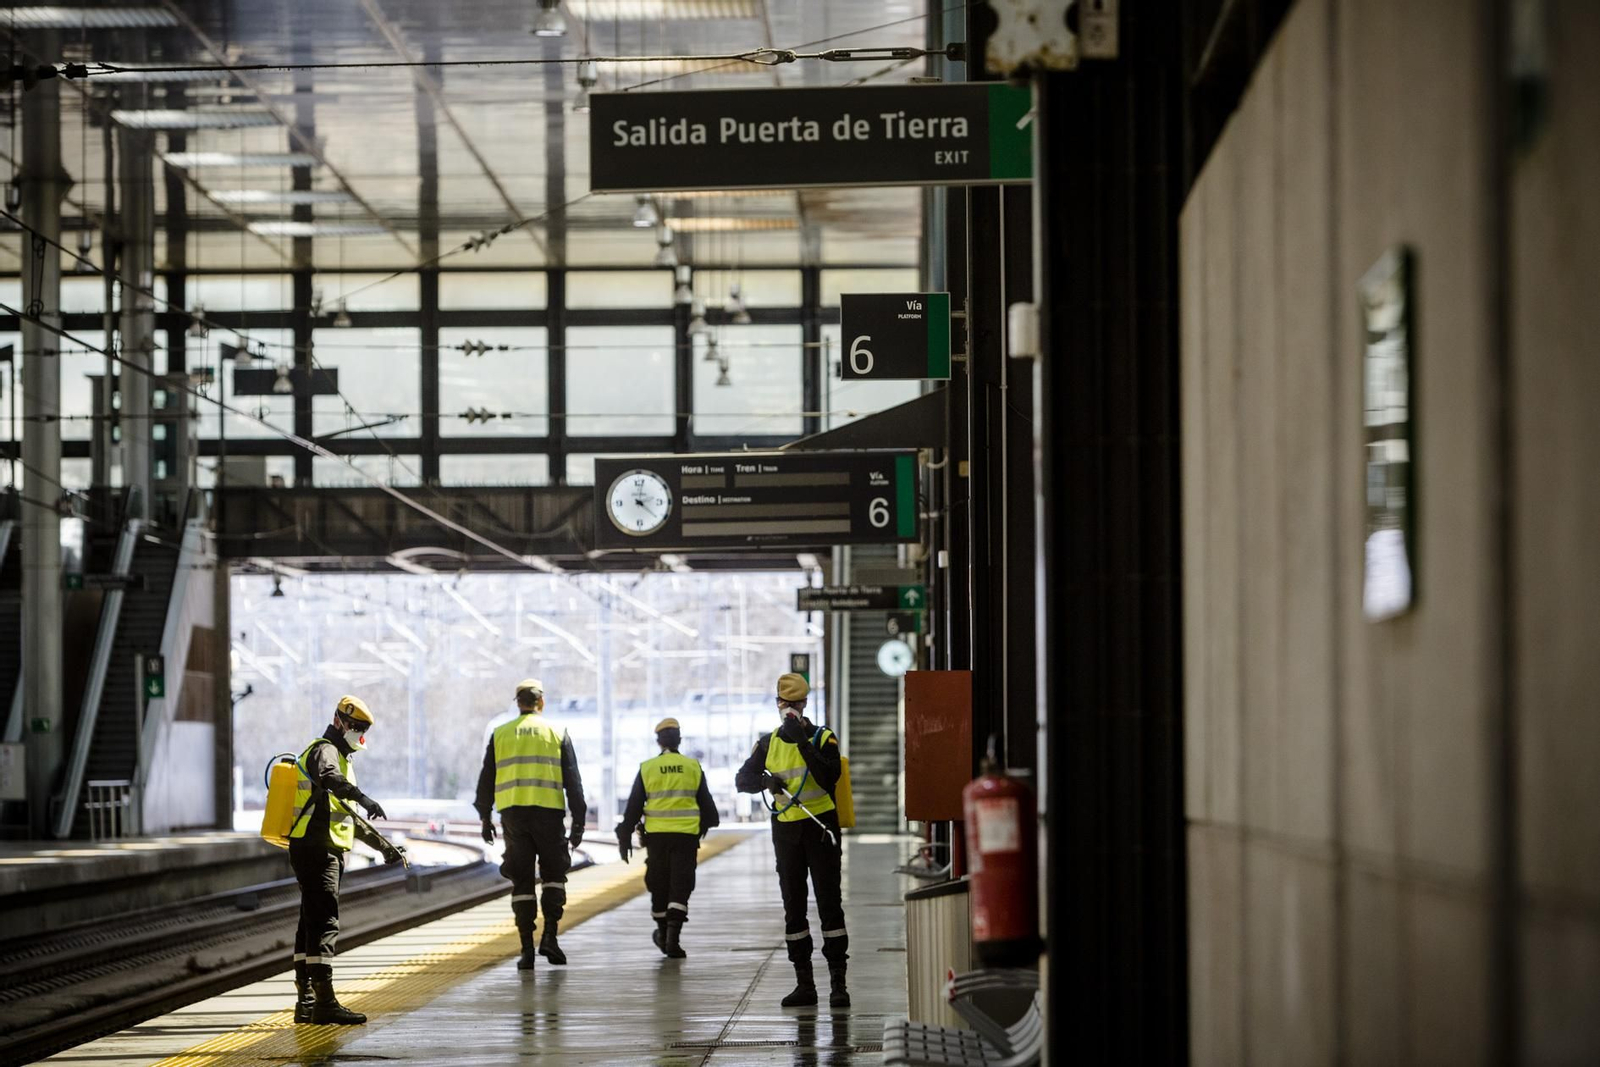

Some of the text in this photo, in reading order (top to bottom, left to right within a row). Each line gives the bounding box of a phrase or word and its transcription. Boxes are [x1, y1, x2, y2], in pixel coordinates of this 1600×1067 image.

[612, 111, 969, 146] Salida Puerta de Tierra
[934, 150, 969, 165] EXIT
[906, 300, 922, 310] Vía
[850, 335, 874, 375] 6
[681, 465, 702, 473] Hora
[735, 464, 756, 472] Tren
[869, 471, 884, 480] Vía
[682, 495, 716, 504] Destino
[869, 497, 890, 528] 6
[660, 765, 684, 774] UME
